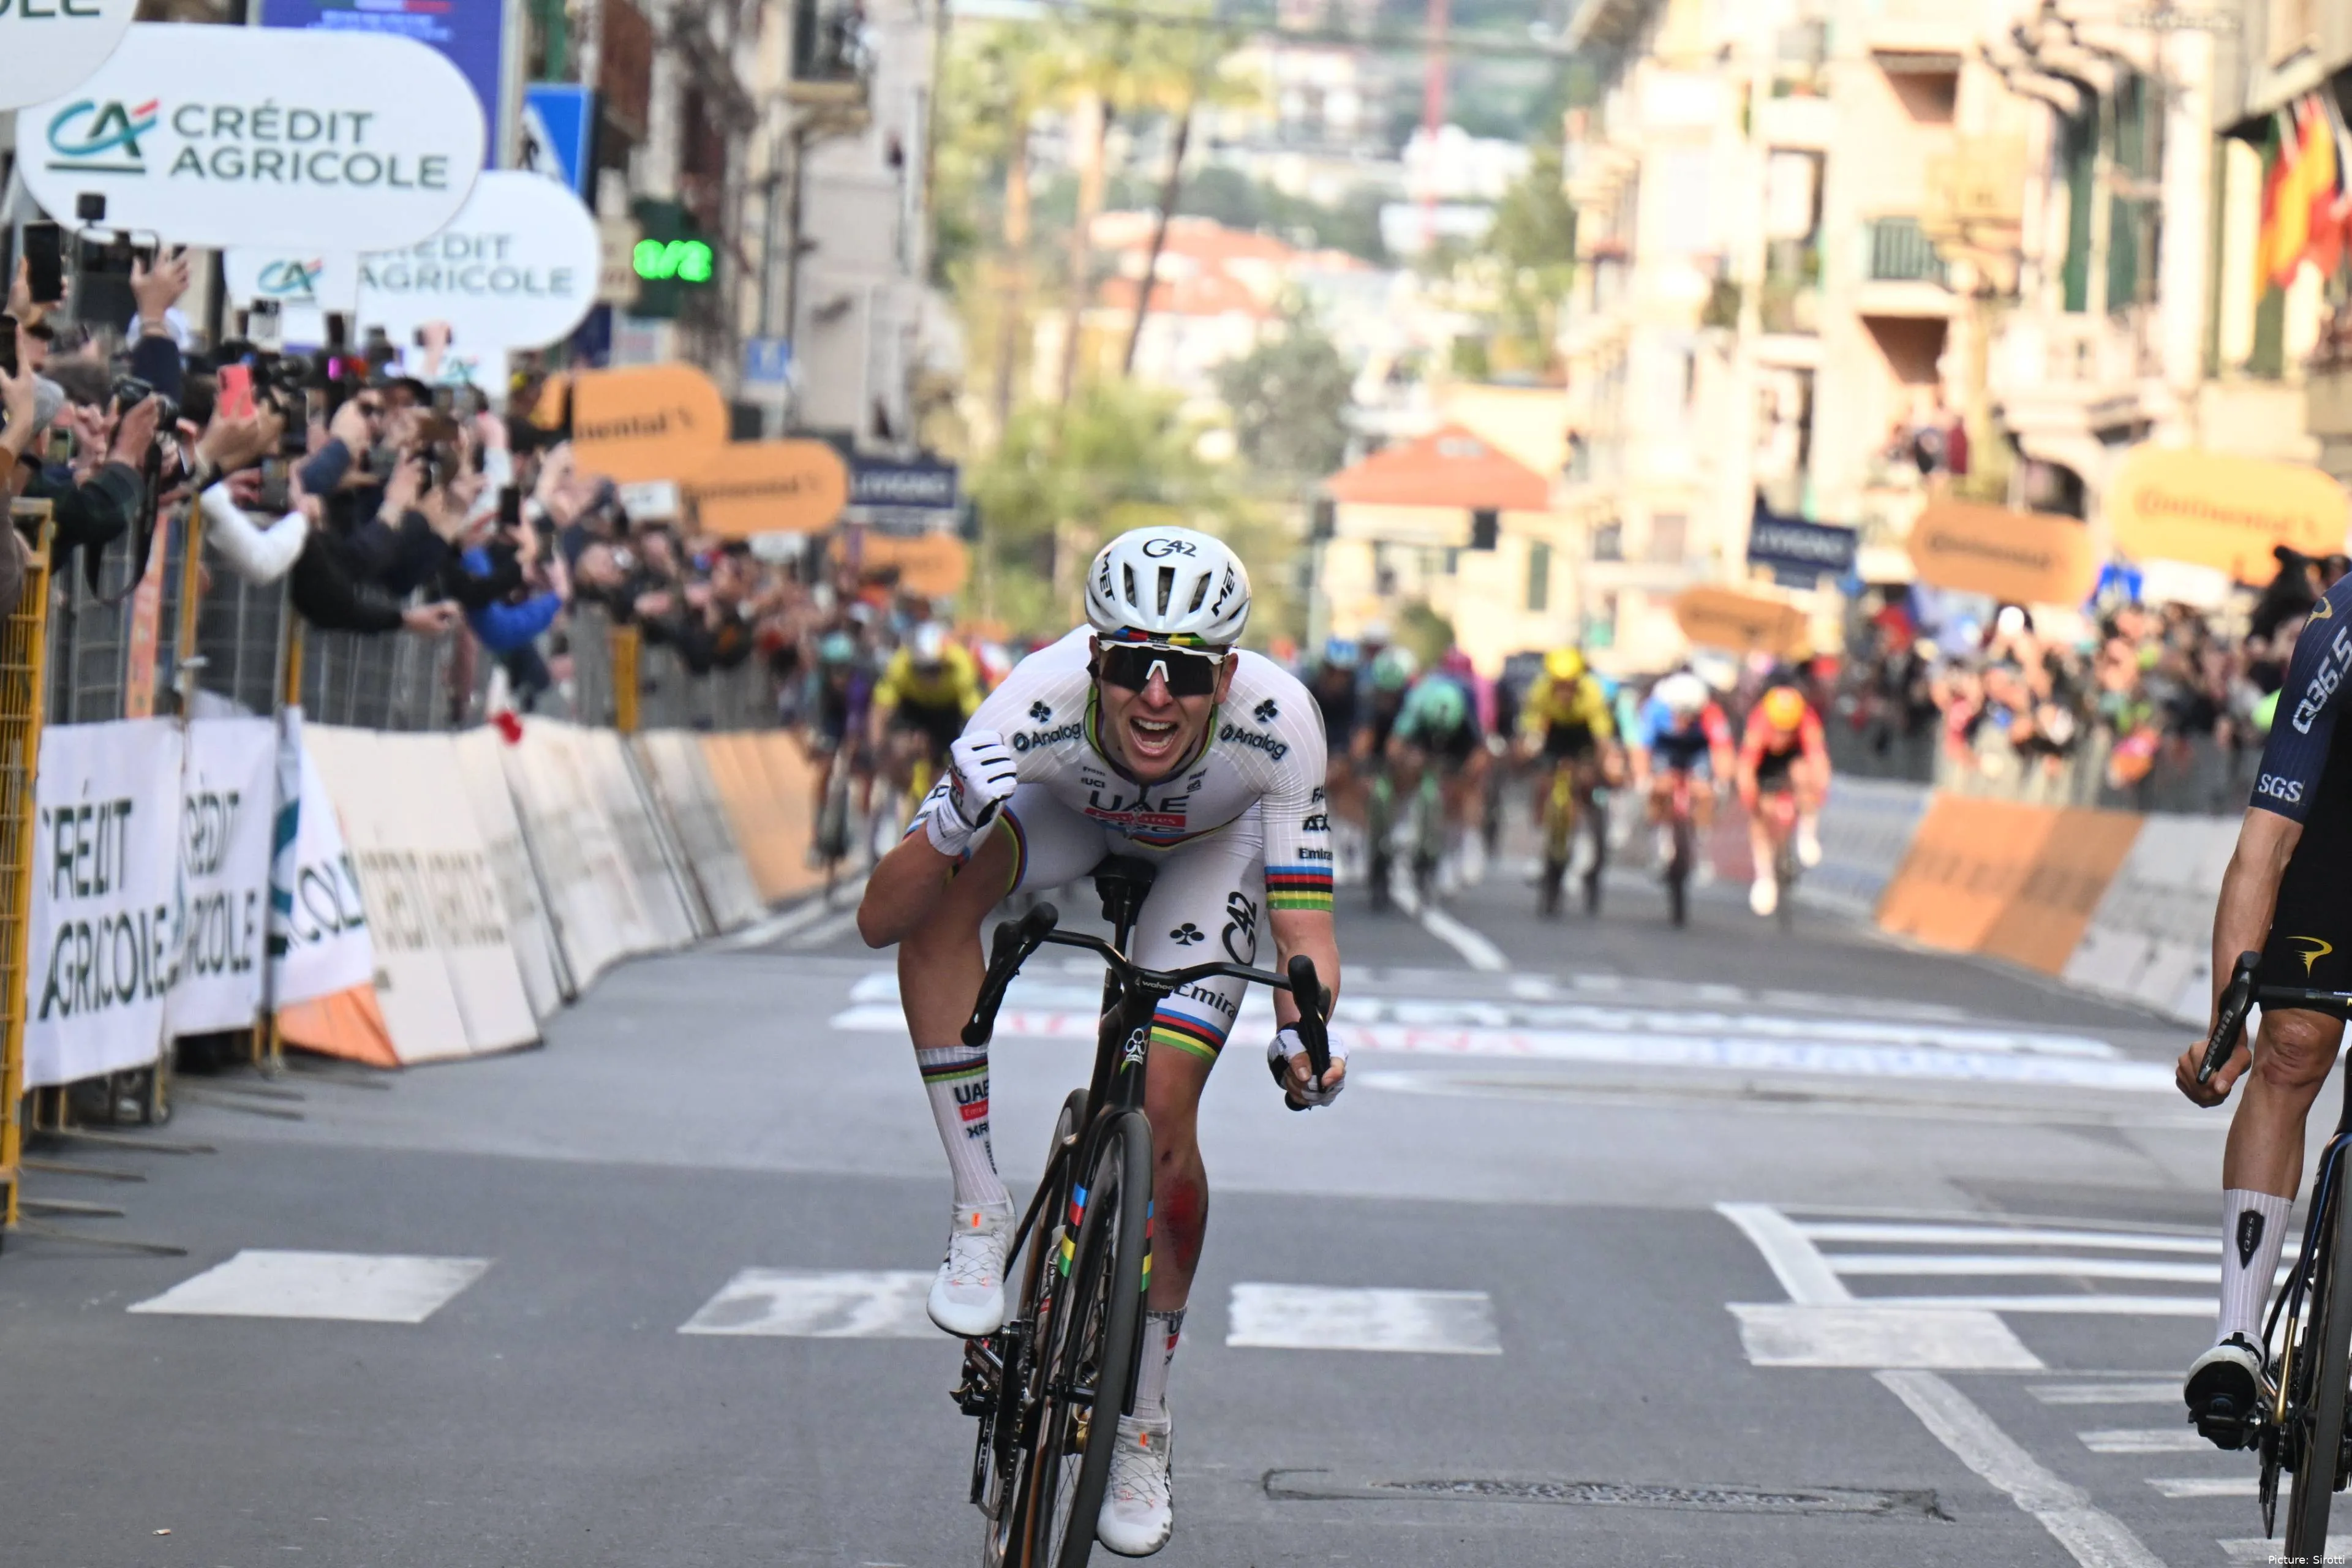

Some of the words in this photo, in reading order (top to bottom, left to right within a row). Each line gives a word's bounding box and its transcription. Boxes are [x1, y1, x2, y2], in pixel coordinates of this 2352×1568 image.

[172, 98, 373, 143] CRÉDIT
[169, 146, 449, 190] AGRICOLE
[1142, 538, 1196, 558] G42
[1211, 562, 1235, 617] MET
[1032, 723, 1081, 748] Analog
[1232, 727, 1287, 760] Analog
[1089, 790, 1190, 813] UAE
[2258, 773, 2303, 802] SGS
[1222, 891, 1257, 967] G42
